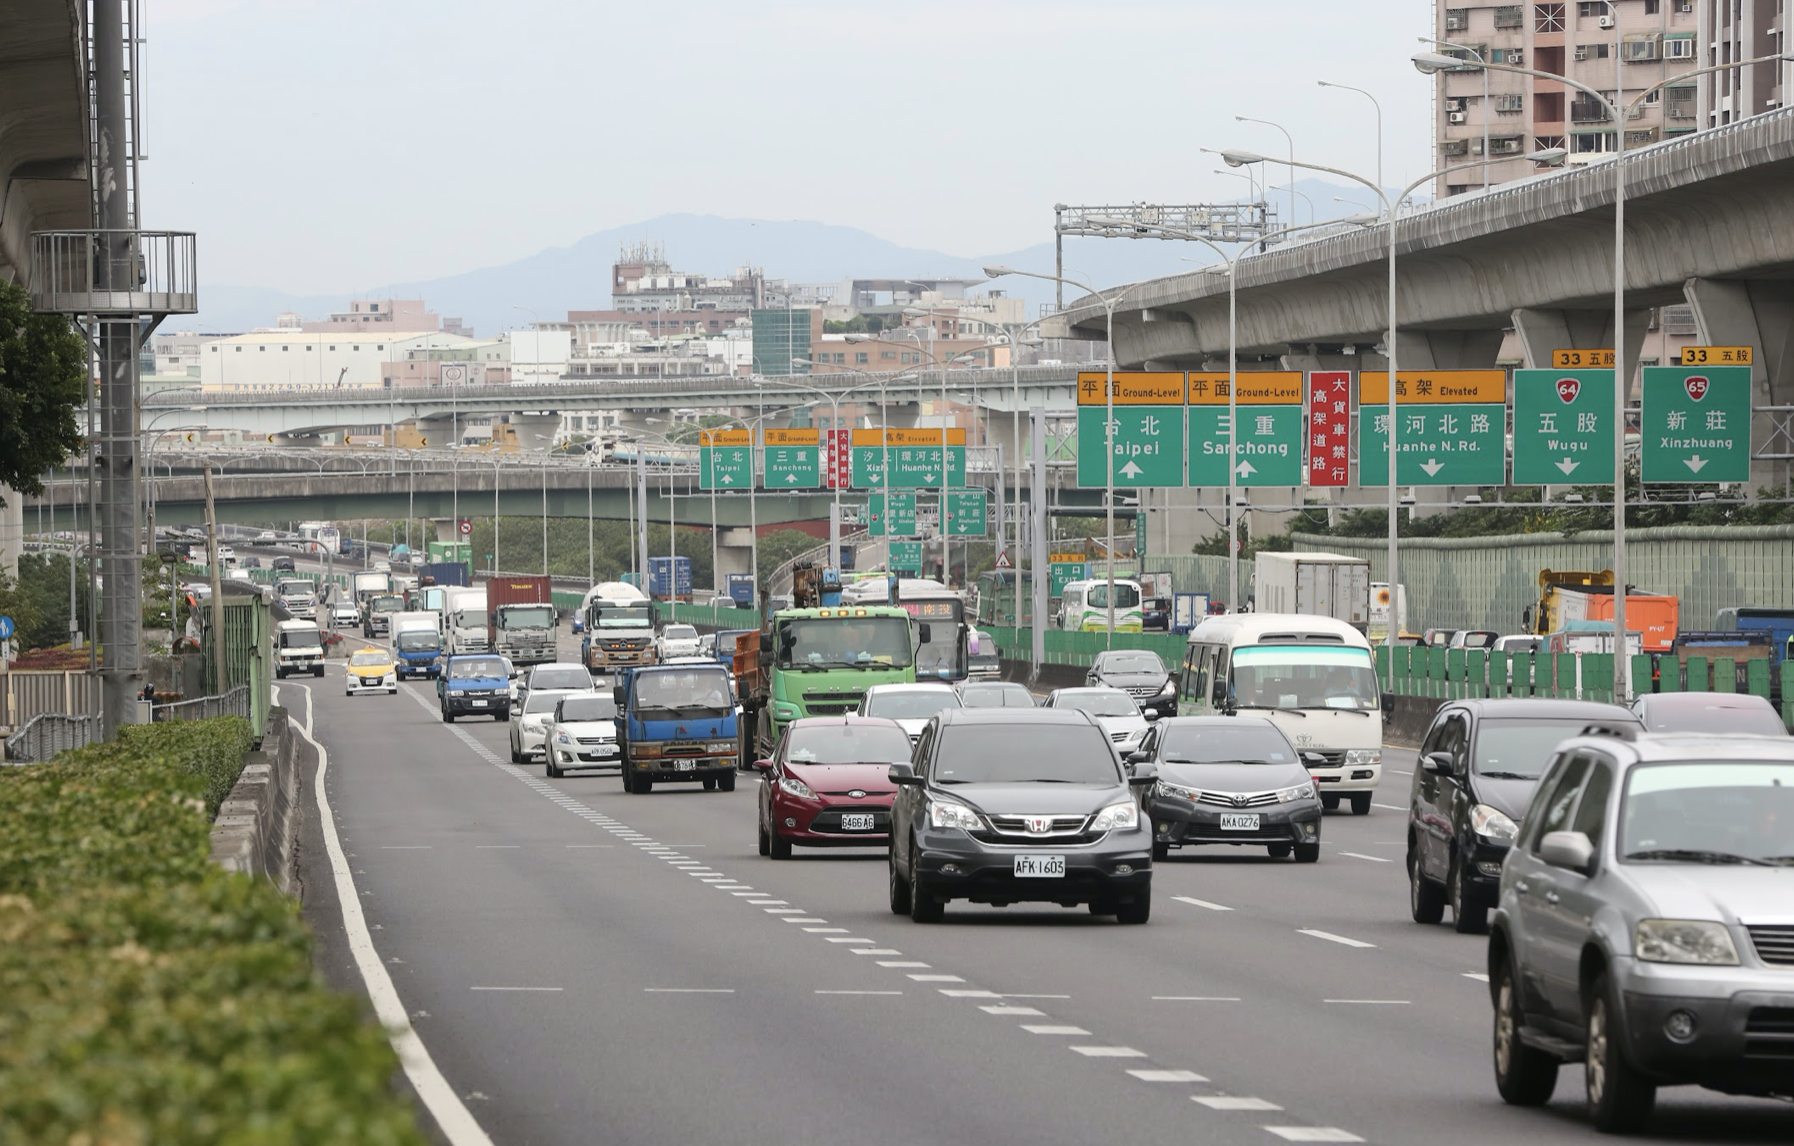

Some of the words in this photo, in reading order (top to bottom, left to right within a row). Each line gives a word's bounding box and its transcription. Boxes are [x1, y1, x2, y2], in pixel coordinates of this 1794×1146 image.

[1560, 353, 1581, 365] 33
[1589, 352, 1616, 365] 五股
[1686, 350, 1707, 362] 33
[1721, 350, 1748, 362] 五股
[1082, 381, 1120, 397] 平面
[1123, 387, 1180, 398] Ground-Level
[1192, 381, 1230, 397] 平面
[1236, 387, 1299, 398] Ground-Level
[1395, 379, 1433, 396] 高架
[1440, 386, 1478, 396] Elevated
[1559, 384, 1576, 394] 64
[1688, 381, 1706, 392] 65
[1102, 415, 1160, 435] 台北
[1215, 415, 1275, 435] 三重
[1373, 413, 1491, 434] 環河北路
[1538, 413, 1598, 433] 五股
[1666, 410, 1727, 430] 新莊
[1312, 389, 1328, 471] 高架道路
[1331, 378, 1347, 481] 大貨車禁行
[1441, 440, 1456, 452] N.
[1458, 440, 1481, 452] Rd.
[1547, 440, 1588, 453] Wugu
[1660, 437, 1734, 450] Xinzhuang
[712, 451, 743, 462] 台北
[777, 450, 808, 462] 三重
[716, 464, 740, 472] Taipei
[901, 463, 932, 472] Huanhe
[1055, 565, 1080, 575] 出口
